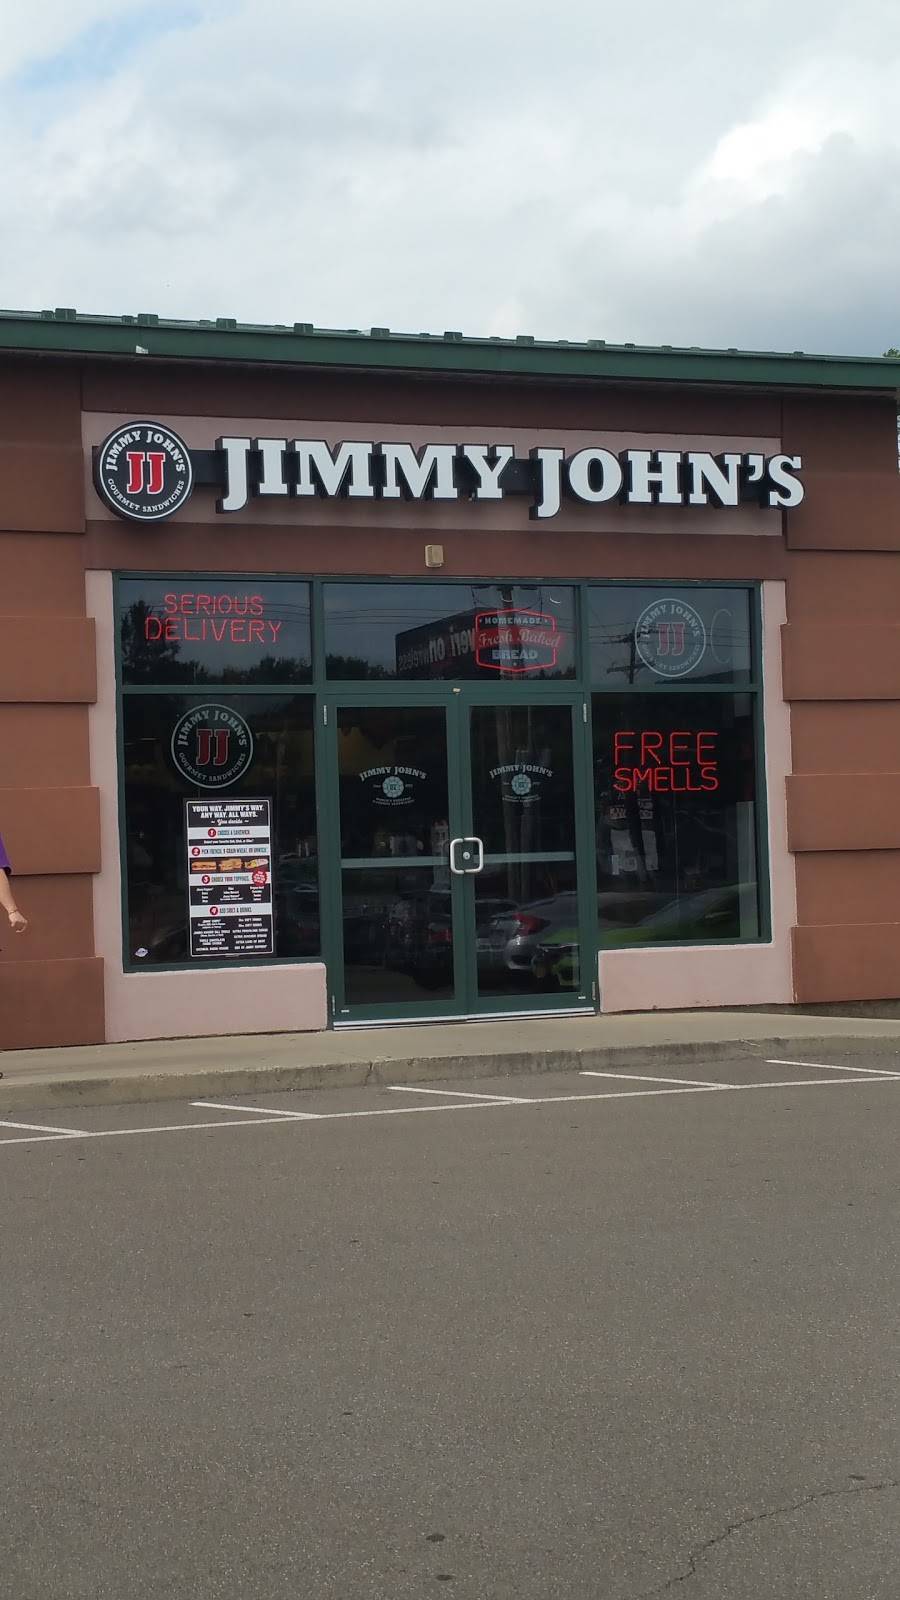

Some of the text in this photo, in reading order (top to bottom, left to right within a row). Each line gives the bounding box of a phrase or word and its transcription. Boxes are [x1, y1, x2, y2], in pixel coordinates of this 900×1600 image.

[106, 431, 186, 472] JIMMY JOHN'S
[126, 452, 166, 494] JJ
[221, 438, 805, 518] JIMMY JOHN'S
[108, 478, 185, 513] GOURMET SANDWICHES
[164, 593, 264, 616] SERIOUS
[144, 616, 282, 643] DELIVERY
[484, 617, 542, 625] HOMEMADE
[479, 629, 561, 649] Fresh Baked
[656, 621, 686, 656] JJ
[492, 649, 538, 660] BREAD
[178, 710, 247, 747] JIMMY JOHN'S
[195, 729, 231, 766] JJ
[613, 731, 719, 766] FREE
[359, 766, 428, 782] JIMMY JOHN'S
[489, 764, 553, 779] JIMMY JOHN'S
[612, 766, 720, 792] SMELLS
[224, 804, 250, 812] JIMMY'S
